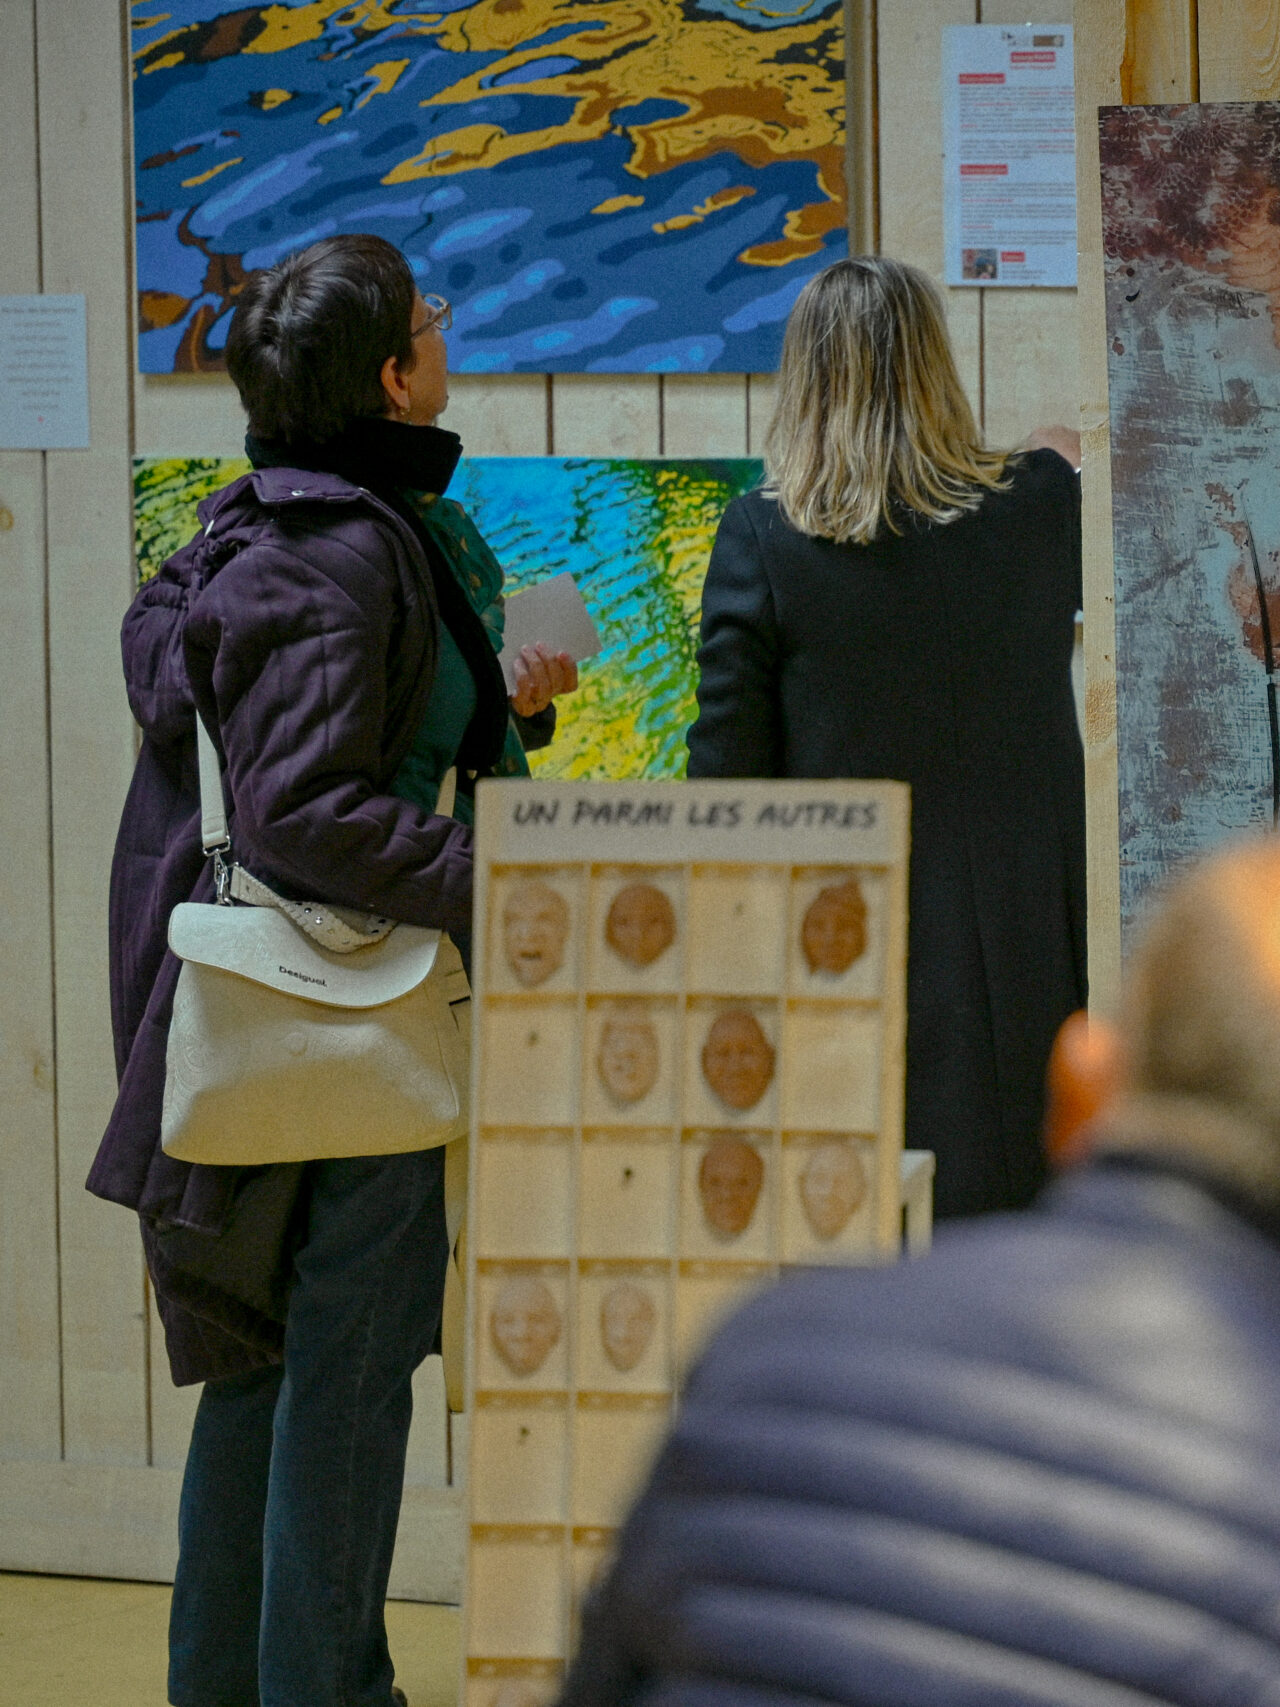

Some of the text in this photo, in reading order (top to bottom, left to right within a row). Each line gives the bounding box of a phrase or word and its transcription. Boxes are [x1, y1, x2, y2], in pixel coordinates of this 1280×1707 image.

[514, 799, 878, 830] UN PARMI LES AUTRES
